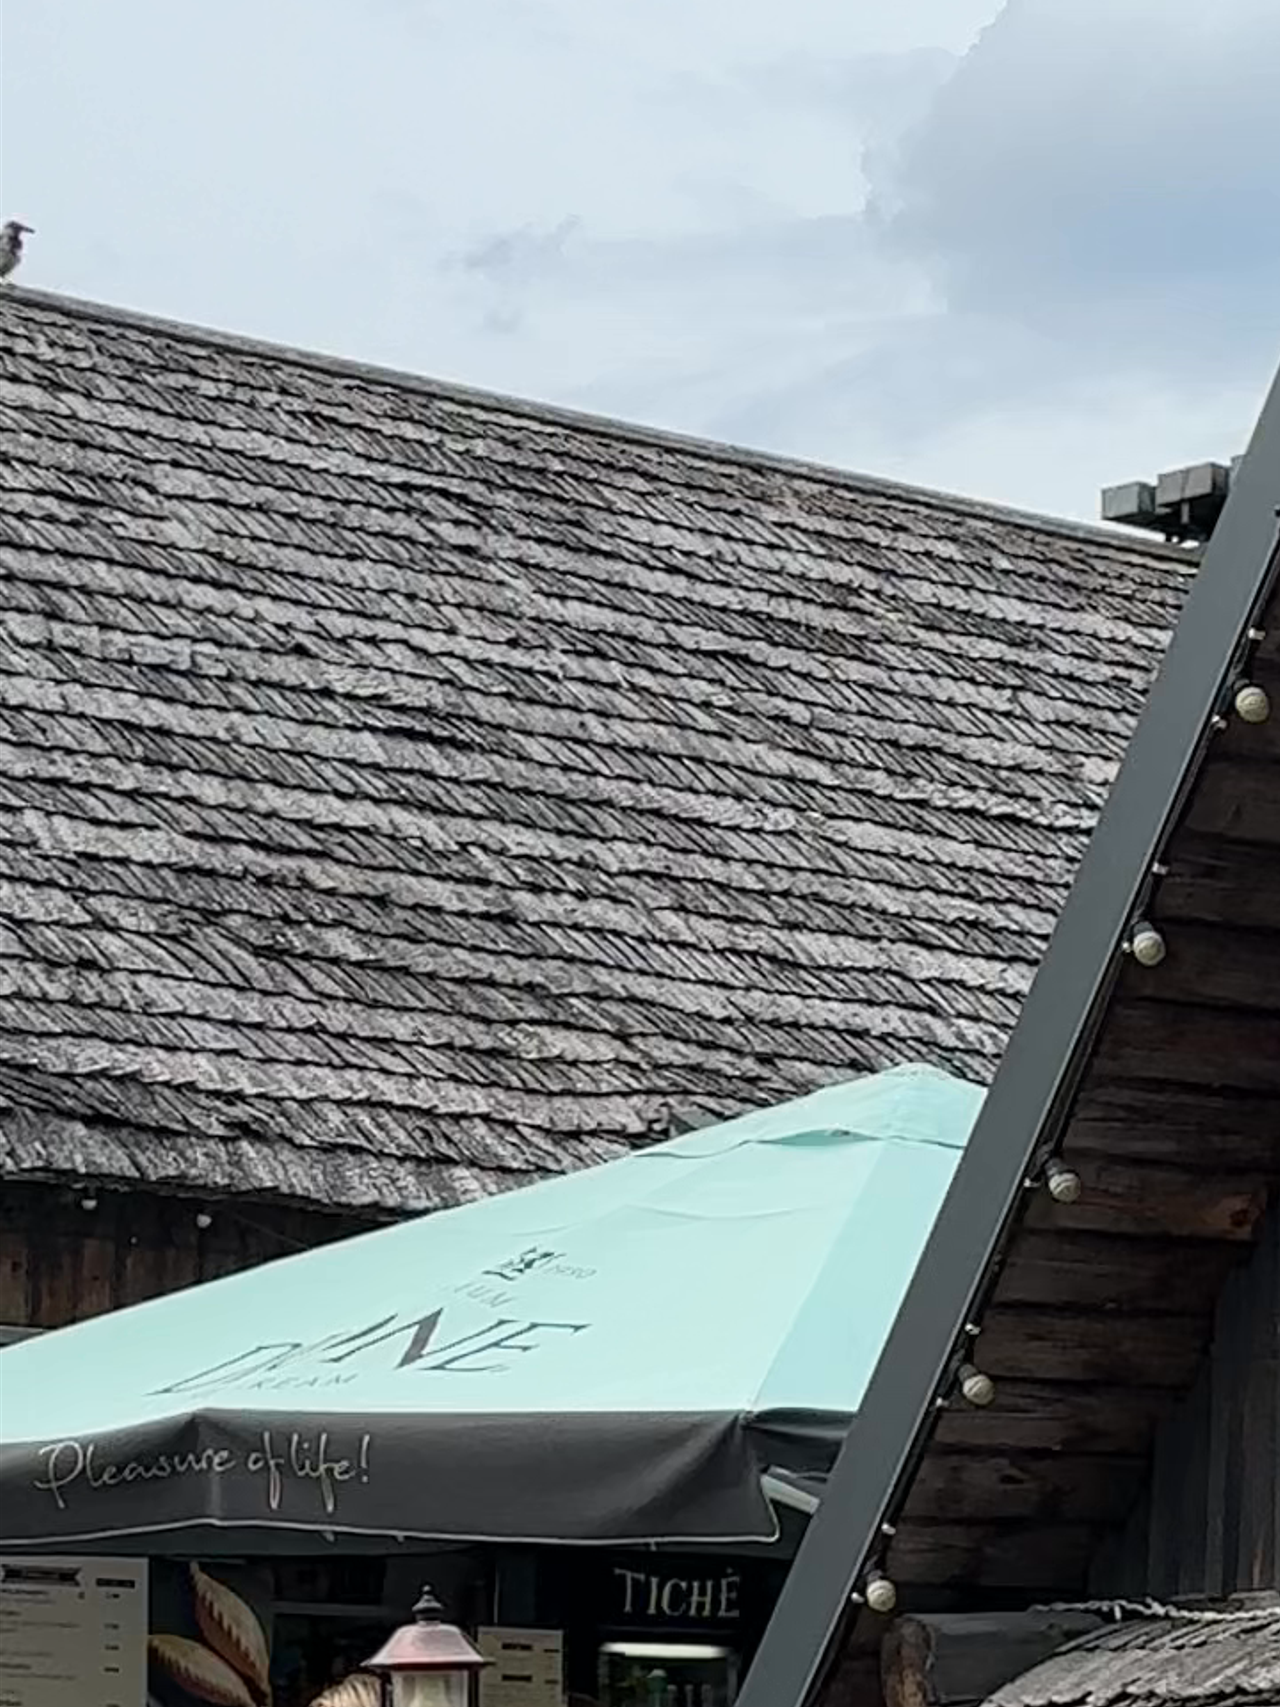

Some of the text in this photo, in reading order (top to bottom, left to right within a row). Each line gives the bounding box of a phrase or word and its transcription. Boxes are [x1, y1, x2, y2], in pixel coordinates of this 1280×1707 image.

[34, 1431, 370, 1513] Pleasure of life!
